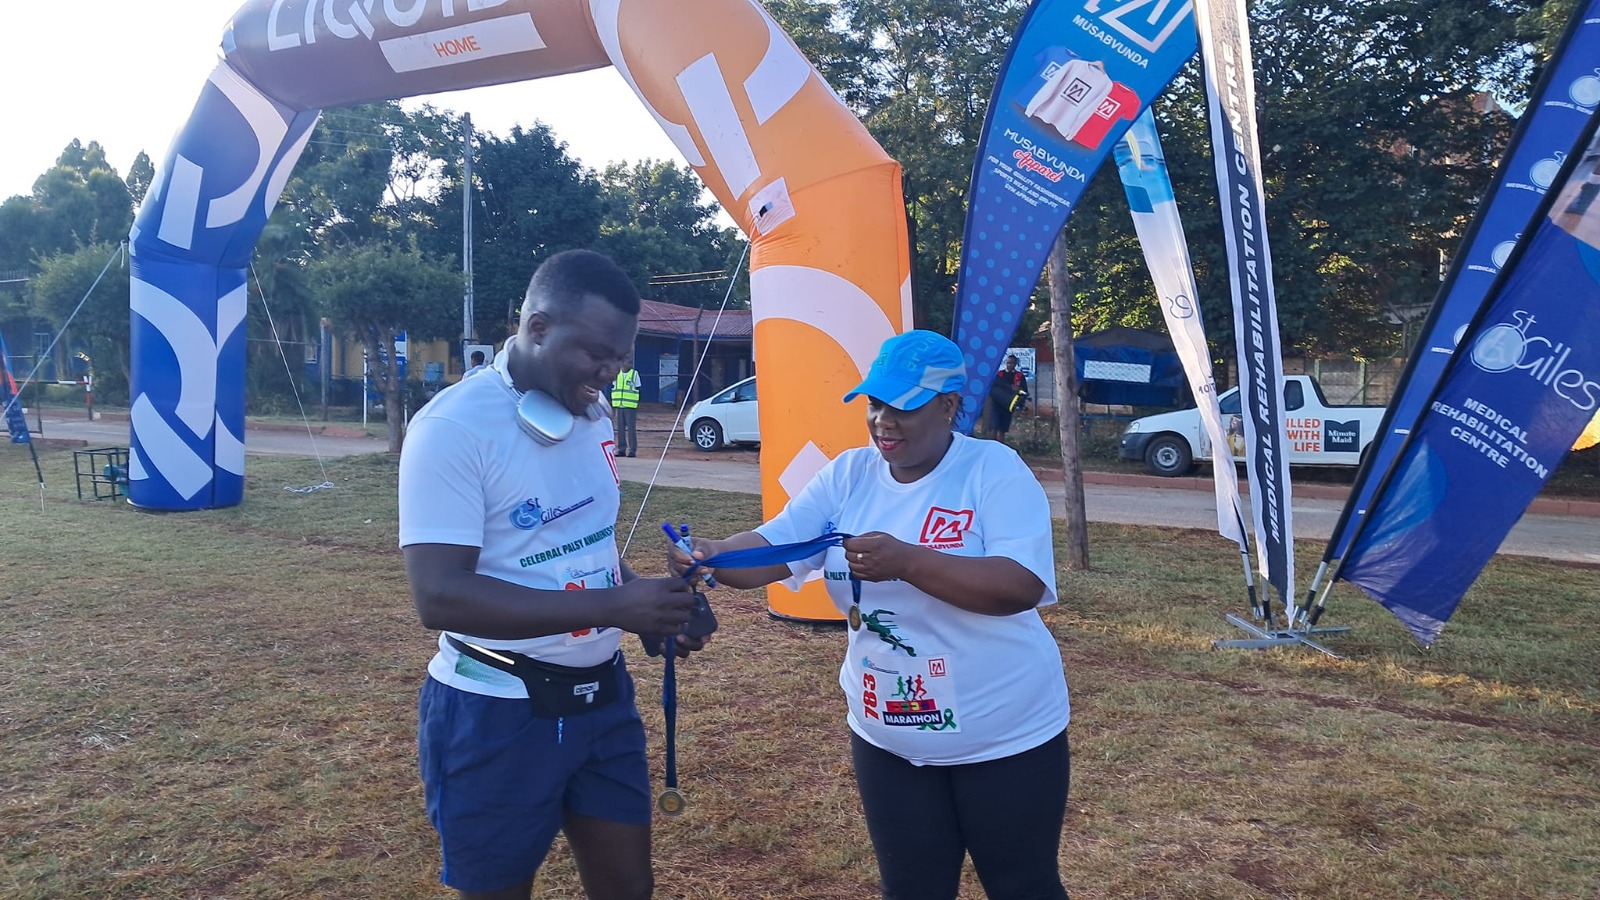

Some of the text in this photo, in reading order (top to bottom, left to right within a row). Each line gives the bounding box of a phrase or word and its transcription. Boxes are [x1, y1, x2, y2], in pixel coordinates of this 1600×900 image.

[433, 35, 481, 58] HOME
[1072, 15, 1149, 69] MUSABVUNDA
[1003, 128, 1085, 183] MUSABVUNDA
[1013, 149, 1065, 183] Apparel
[994, 168, 1014, 183] SPORTS
[1222, 42, 1281, 545] MEDICAL REHABILITATION CENTRE
[1513, 310, 1537, 334] St
[1514, 336, 1600, 410] Giles
[1286, 418, 1321, 428] ILLED
[1287, 430, 1320, 440] WITH
[1463, 398, 1528, 444] MEDICAL
[1294, 442, 1320, 452] LIFE
[1431, 401, 1548, 479] REHABILITATION
[1450, 426, 1510, 468] CENTRE
[527, 497, 541, 511] St
[541, 506, 563, 522] Giles
[519, 548, 562, 568] CELEBRAL
[562, 539, 584, 555] PALSY
[863, 673, 879, 720] 783
[885, 713, 940, 724] MARATHON
